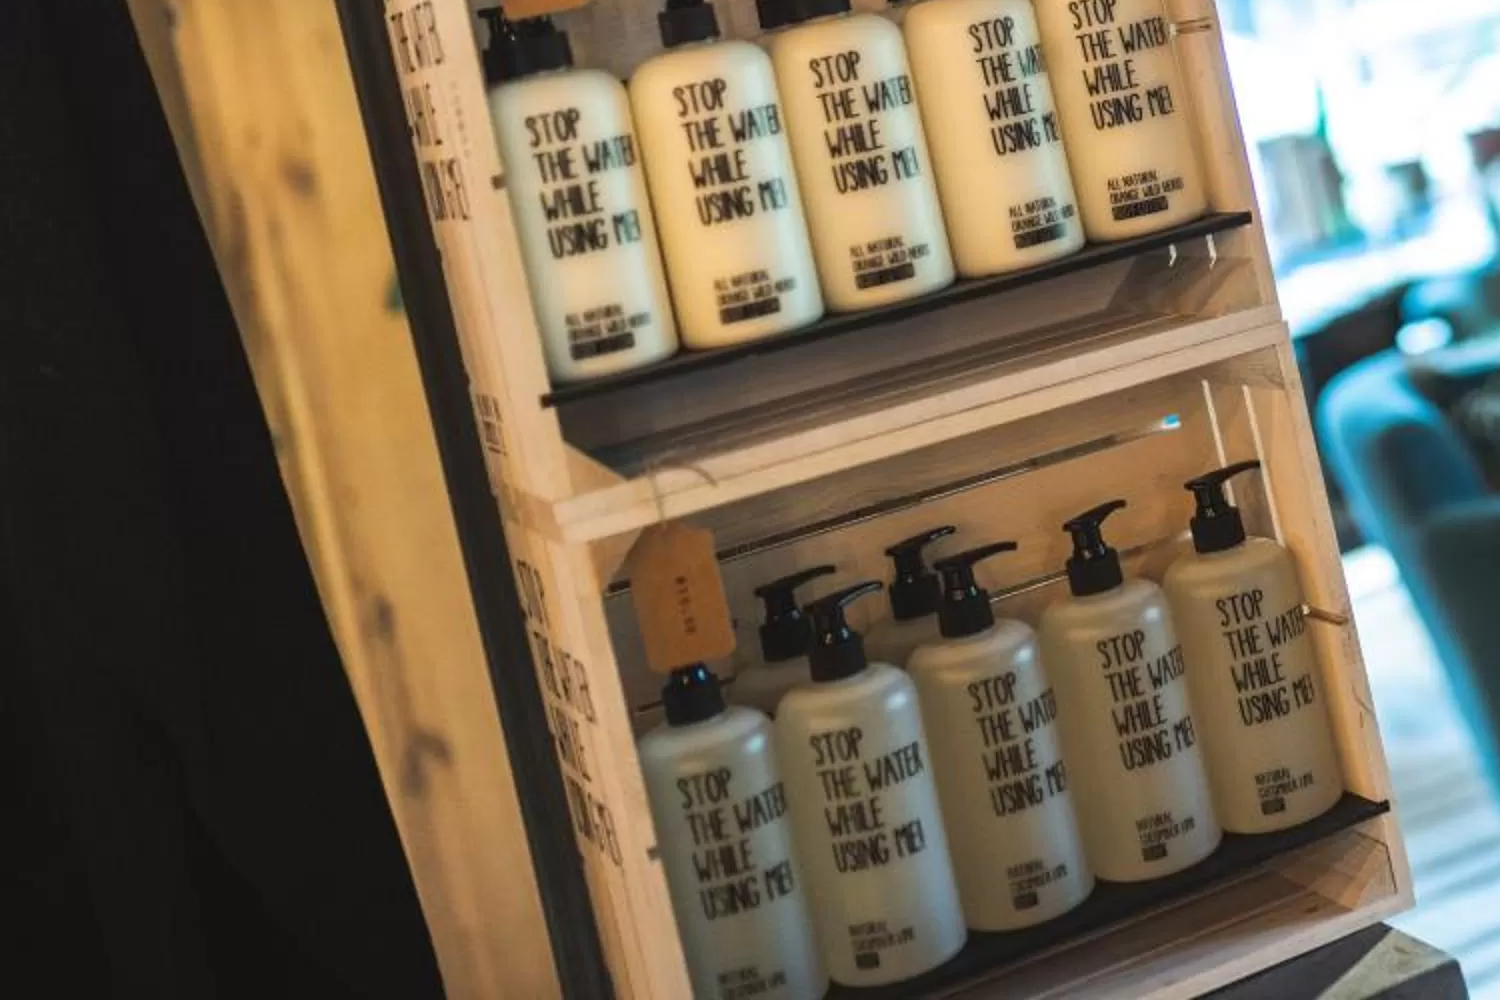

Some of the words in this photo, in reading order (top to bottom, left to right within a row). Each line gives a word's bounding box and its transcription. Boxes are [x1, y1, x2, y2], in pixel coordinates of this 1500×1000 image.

[968, 15, 1014, 53] STOP
[1076, 30, 1117, 63] THE
[809, 50, 861, 89] STOP
[976, 51, 1016, 87] THE
[1082, 59, 1140, 96] WHILE
[672, 77, 727, 118] STOP
[816, 87, 860, 123] THE
[983, 83, 1036, 121] WHILE
[1090, 93, 1143, 131] USING
[525, 106, 580, 147] STOP
[680, 117, 725, 151] THE
[824, 119, 885, 158] WHILE
[991, 117, 1041, 156] USING
[532, 147, 579, 184] THE
[688, 149, 750, 188] WHILE
[832, 154, 889, 195] USING
[540, 180, 604, 222] WHILE
[695, 185, 754, 226] USING
[548, 217, 609, 259] USING
[1216, 589, 1263, 627] STOP
[1097, 629, 1145, 669] STOP
[1222, 624, 1264, 661] THE
[968, 671, 1016, 713] STOP
[1104, 666, 1145, 703] THE
[1230, 652, 1286, 694] WHILE
[1112, 695, 1168, 737] WHILE
[1238, 686, 1290, 727] USING
[810, 726, 863, 766] STOP
[976, 709, 1019, 748] THE
[816, 765, 862, 800] THE
[864, 740, 924, 792] WATER
[982, 737, 1039, 781] WHILE
[1119, 729, 1171, 771] USING
[676, 765, 732, 809] STOP
[990, 774, 1043, 816] USING
[685, 807, 732, 845] THE
[824, 795, 885, 837] WHILE
[692, 838, 757, 882] WHILE
[832, 831, 890, 873] USING
[700, 875, 761, 921] USING
